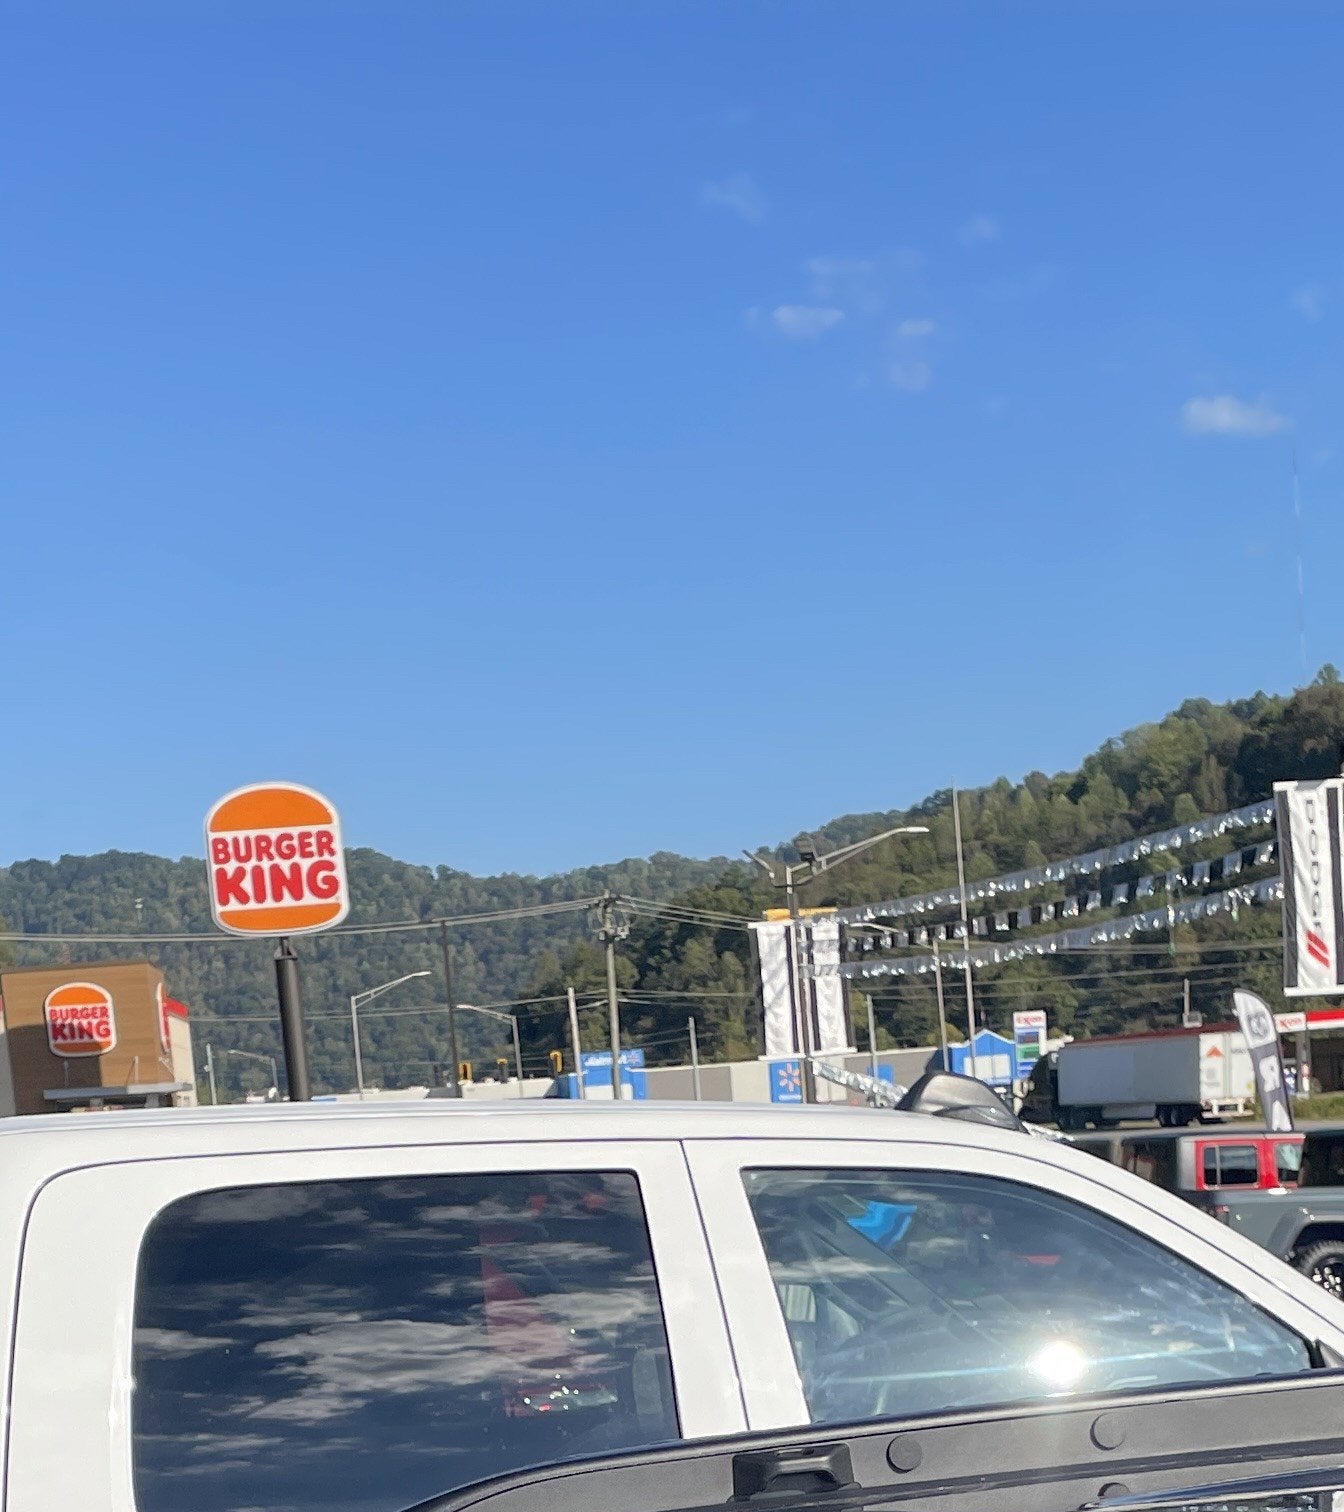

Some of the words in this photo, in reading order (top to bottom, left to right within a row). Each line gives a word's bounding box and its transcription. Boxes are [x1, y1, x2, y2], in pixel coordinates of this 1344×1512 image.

[211, 830, 336, 865] BURGER
[214, 860, 339, 907] KING
[49, 1006, 109, 1021] BURGER
[51, 1020, 111, 1041] KING
